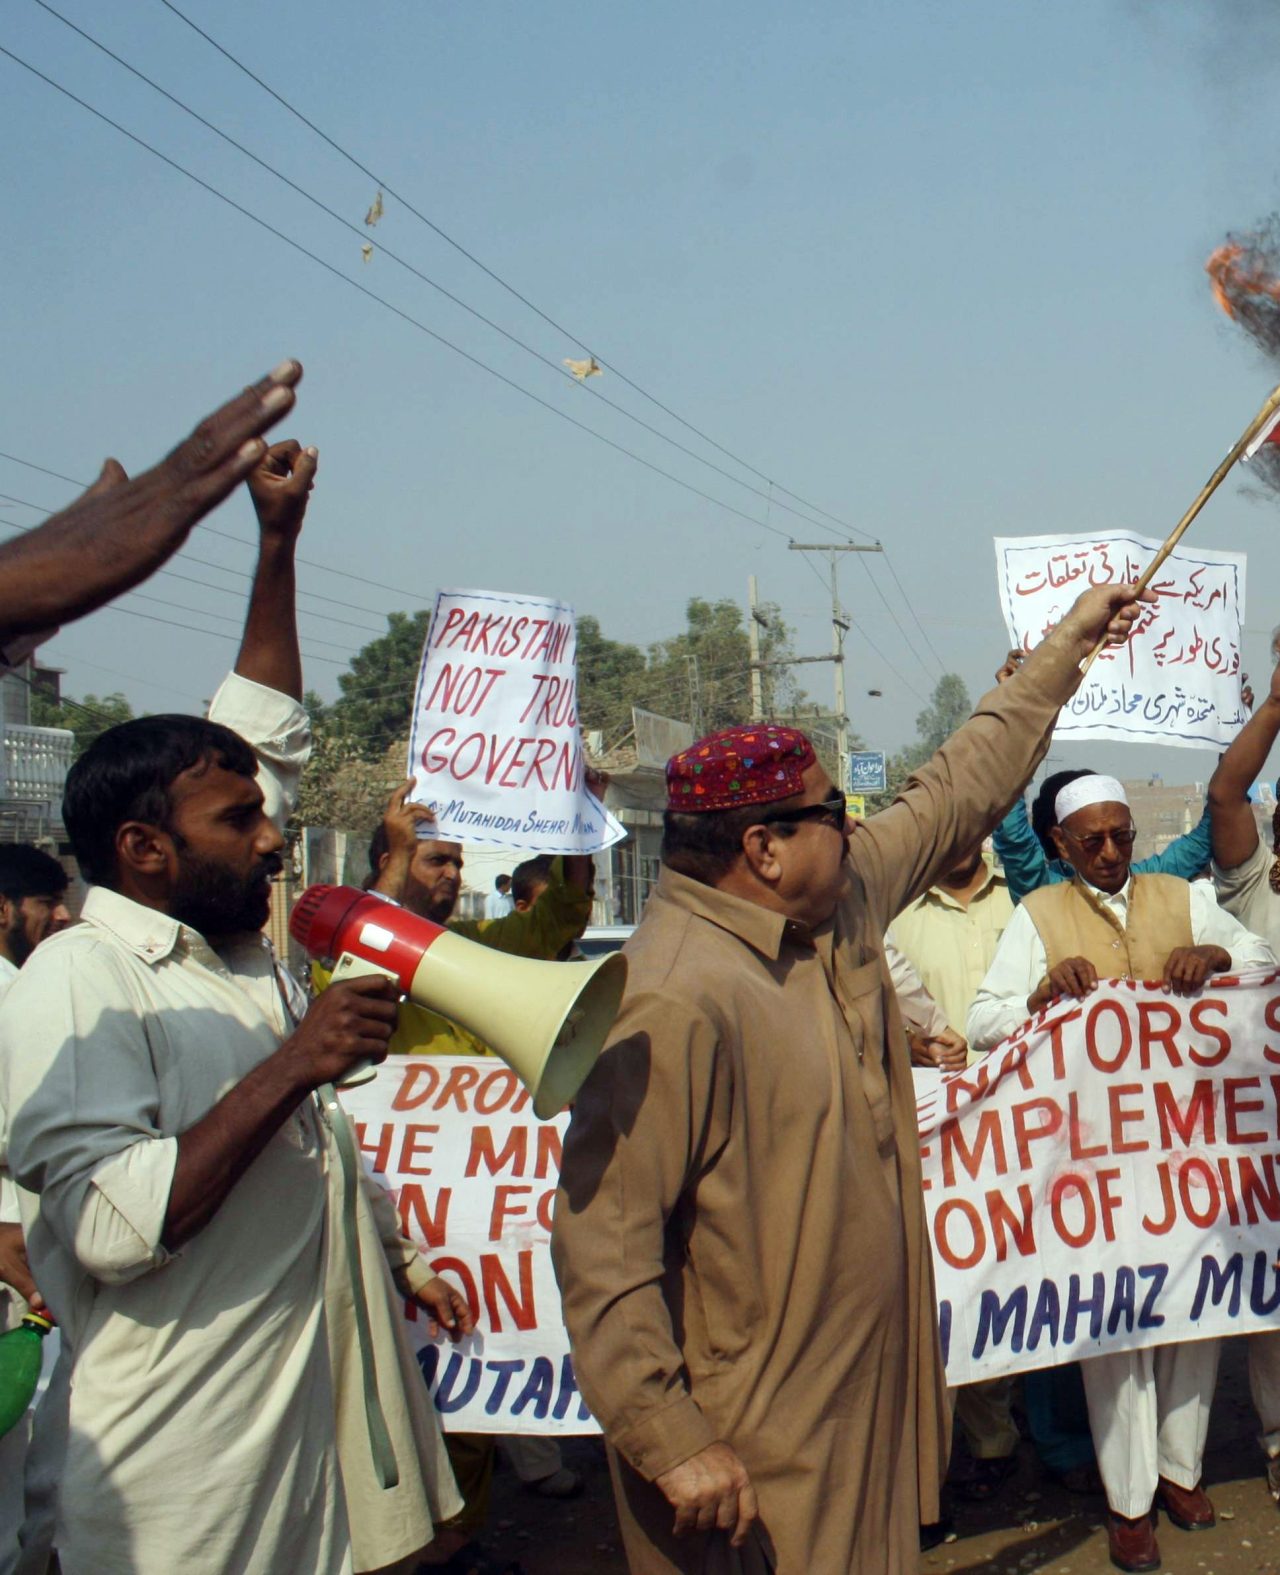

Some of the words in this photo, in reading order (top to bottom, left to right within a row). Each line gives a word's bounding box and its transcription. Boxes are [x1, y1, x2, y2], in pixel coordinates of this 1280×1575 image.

[1015, 551, 1090, 596] تعلقات
[1089, 543, 1141, 587] فارتی
[1151, 580, 1184, 597] سے
[1184, 567, 1227, 611] امریکہ
[435, 608, 570, 664] PAKISTANI
[1127, 604, 1160, 680] ختم
[1152, 626, 1175, 667] پر
[1168, 624, 1203, 664] طور
[1197, 640, 1240, 675] فوری
[425, 663, 506, 717] NOT
[1107, 684, 1143, 715] محاذ
[1143, 687, 1186, 727] شہری
[421, 727, 584, 792] GOVERN
[441, 800, 524, 832] MUTAHIDDA
[523, 810, 569, 835] SHEHRI
[356, 1123, 440, 1176] HE
[917, 999, 1232, 1116] NATORS
[405, 1250, 538, 1333] ON
[934, 1184, 1037, 1270] ON
[1051, 1168, 1123, 1248] OF
[972, 1263, 1169, 1359] MAHAZ
